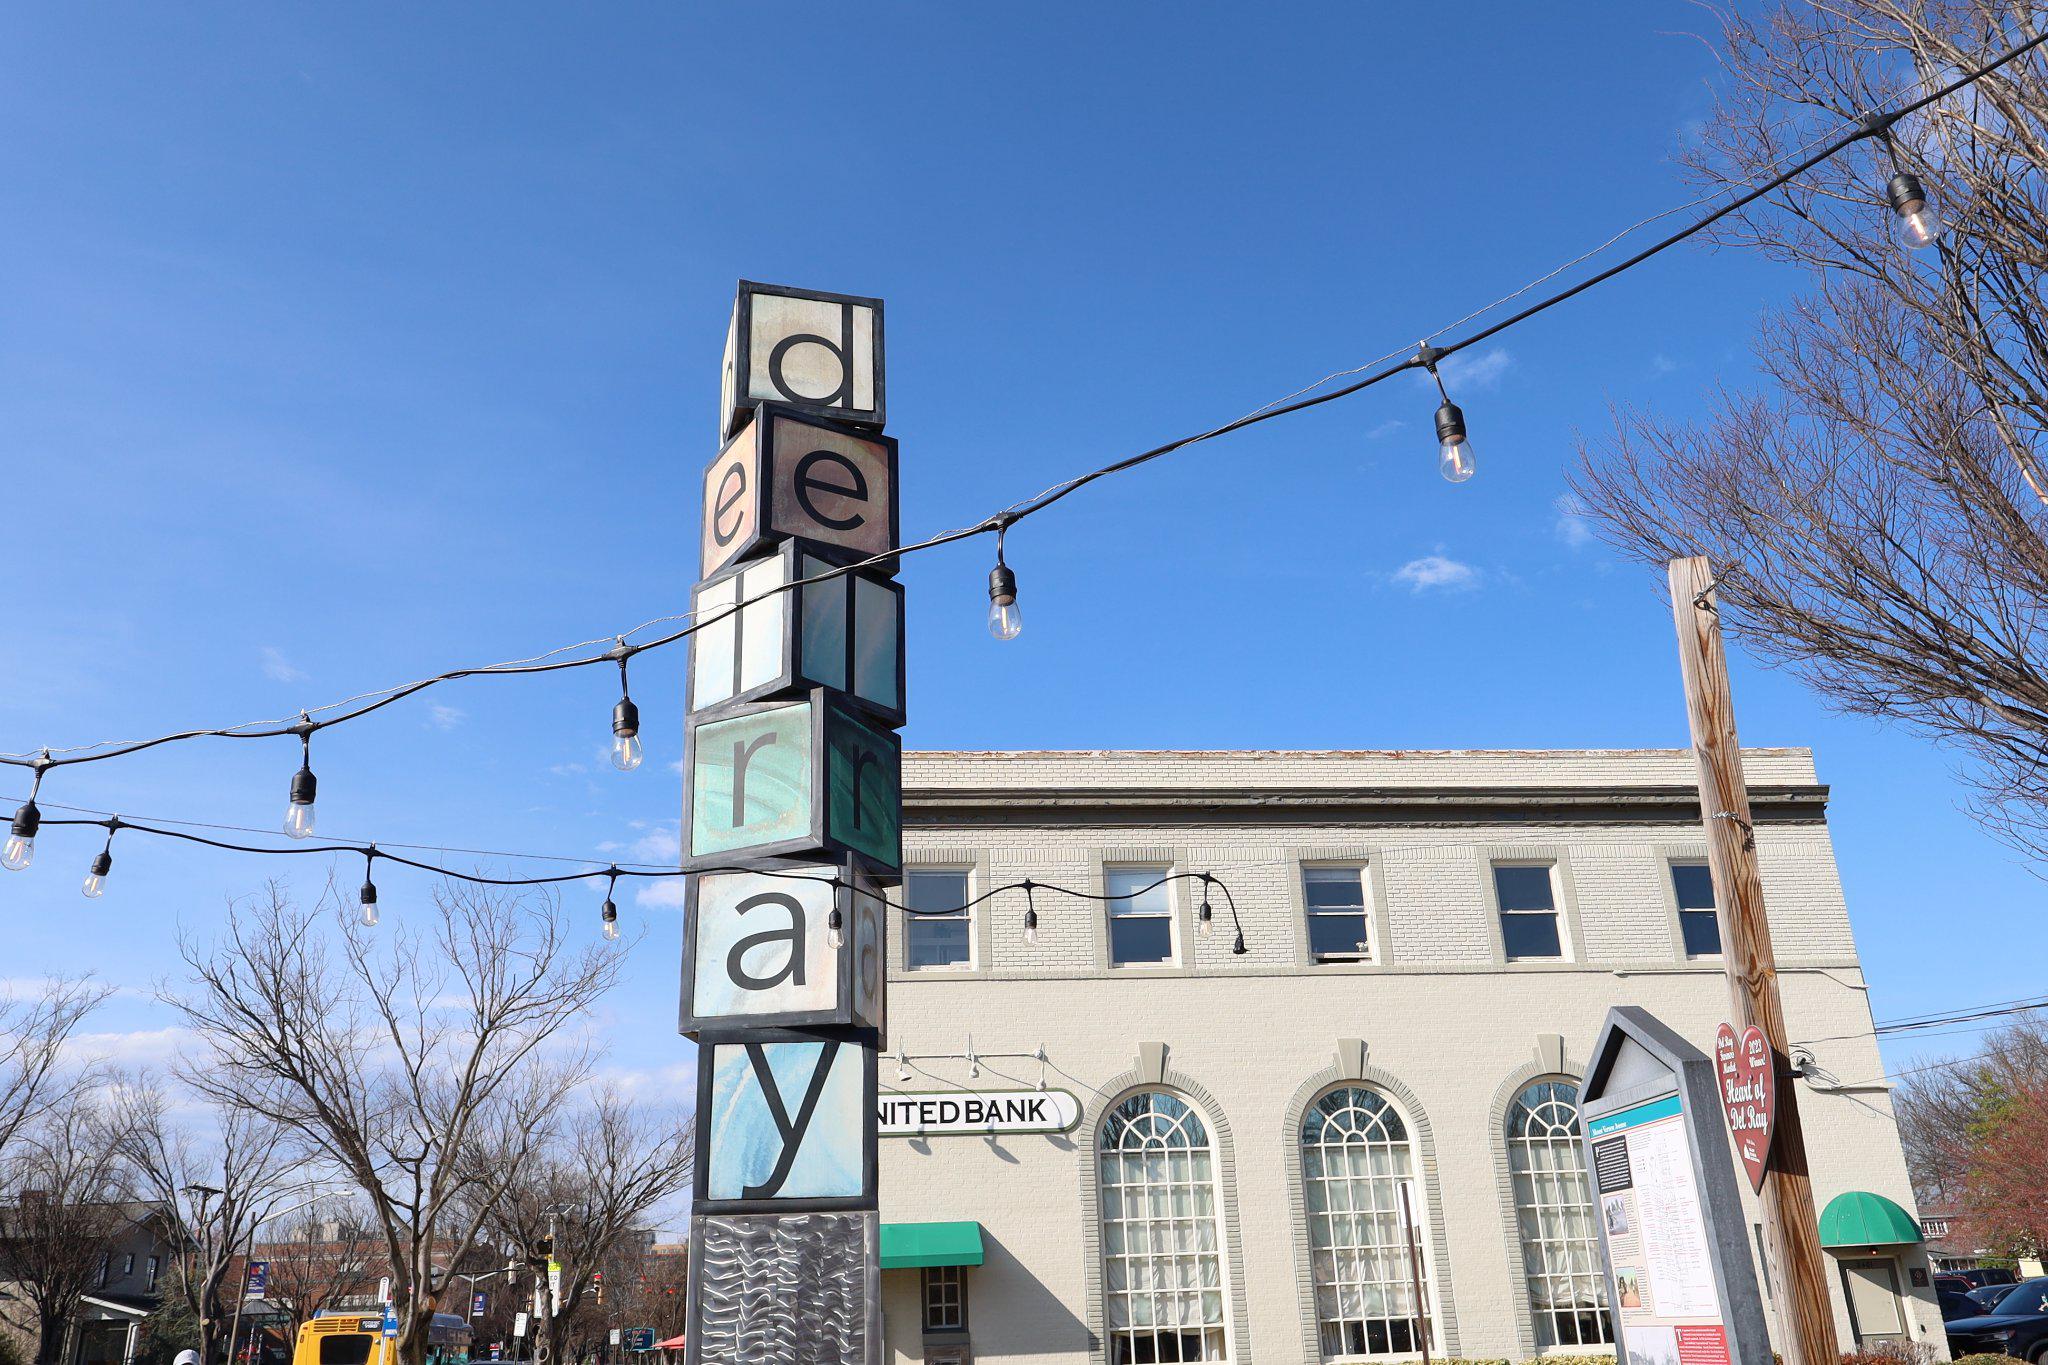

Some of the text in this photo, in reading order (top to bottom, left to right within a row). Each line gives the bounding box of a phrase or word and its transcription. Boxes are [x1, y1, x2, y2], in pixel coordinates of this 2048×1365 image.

[794, 449, 868, 531] e
[732, 732, 777, 828] r
[726, 892, 806, 990] a
[741, 1043, 840, 1199] y
[965, 1099, 1047, 1123] BANK
[1726, 1073, 1766, 1107] Heart of
[1731, 1105, 1768, 1135] Del Ray
